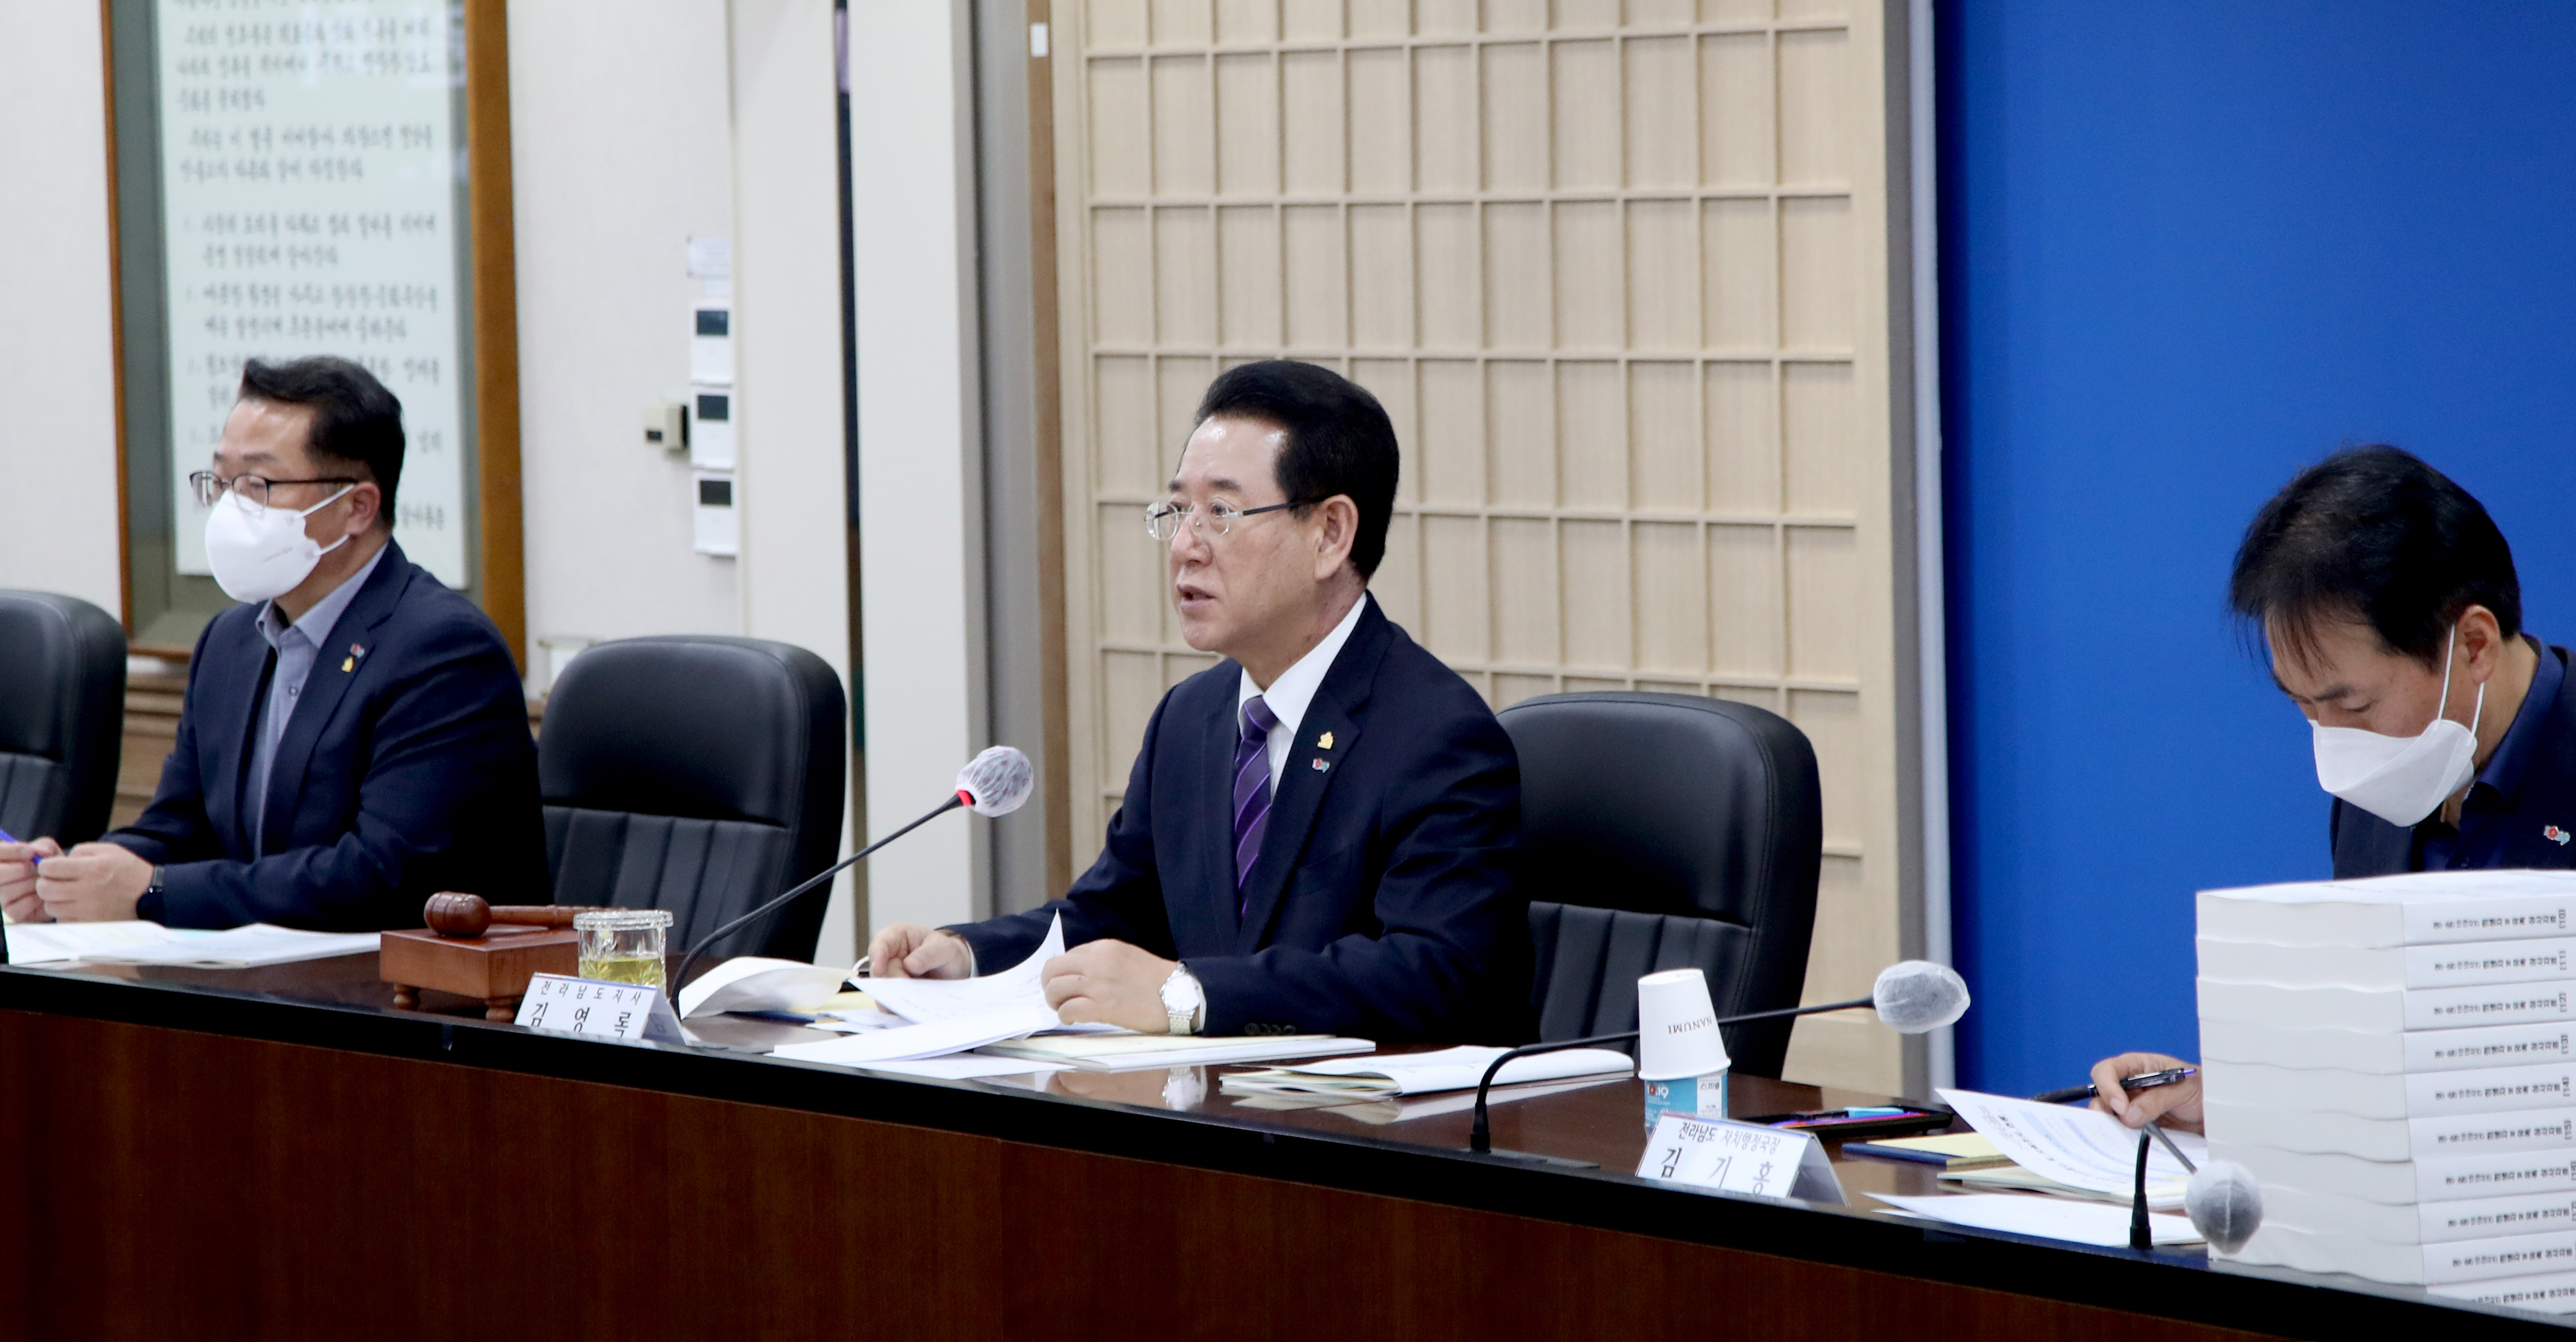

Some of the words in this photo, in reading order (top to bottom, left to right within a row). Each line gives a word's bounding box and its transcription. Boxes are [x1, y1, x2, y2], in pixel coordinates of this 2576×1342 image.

[1668, 1016, 1712, 1034] NANUMI
[1679, 1122, 1718, 1142] 전라남도
[1721, 1130, 1781, 1155] 자치행정국장
